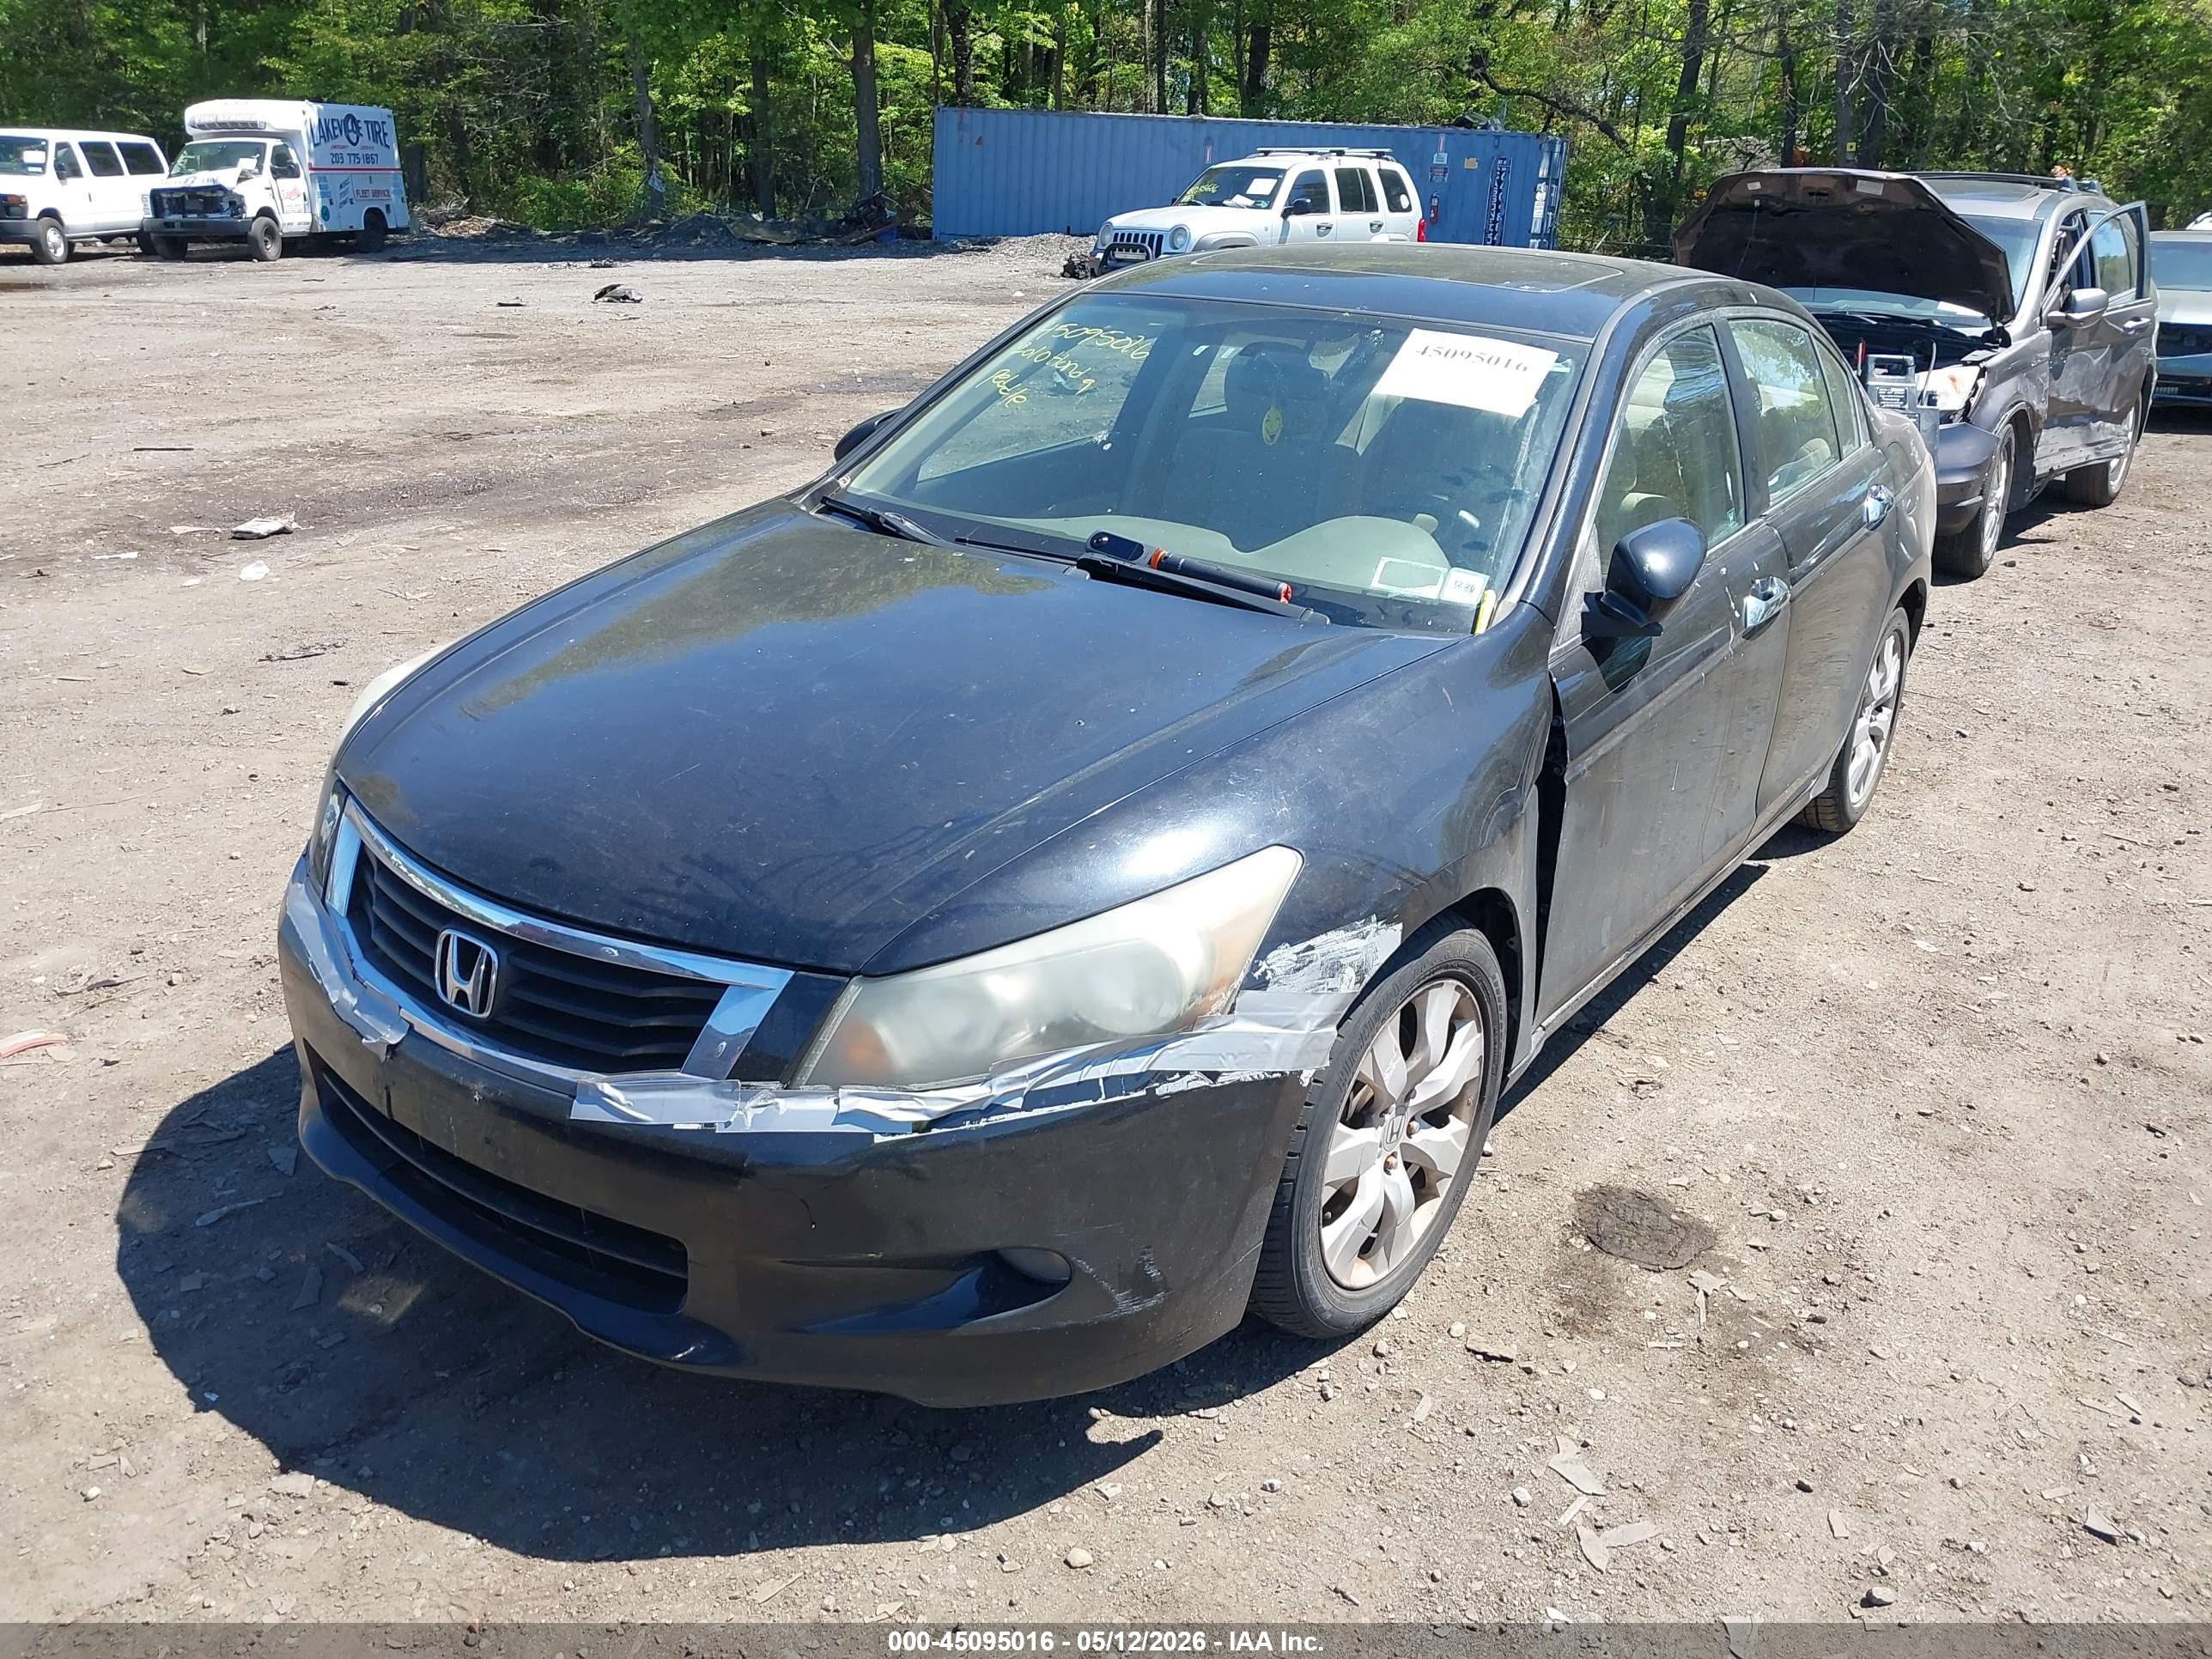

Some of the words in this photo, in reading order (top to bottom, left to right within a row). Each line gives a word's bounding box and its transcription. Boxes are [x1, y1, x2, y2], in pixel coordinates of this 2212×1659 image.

[364, 119, 390, 149] TIRE
[330, 152, 344, 165] 203
[347, 153, 361, 165] 775
[362, 153, 379, 166] 1867
[1416, 345, 1528, 372] 45095016
